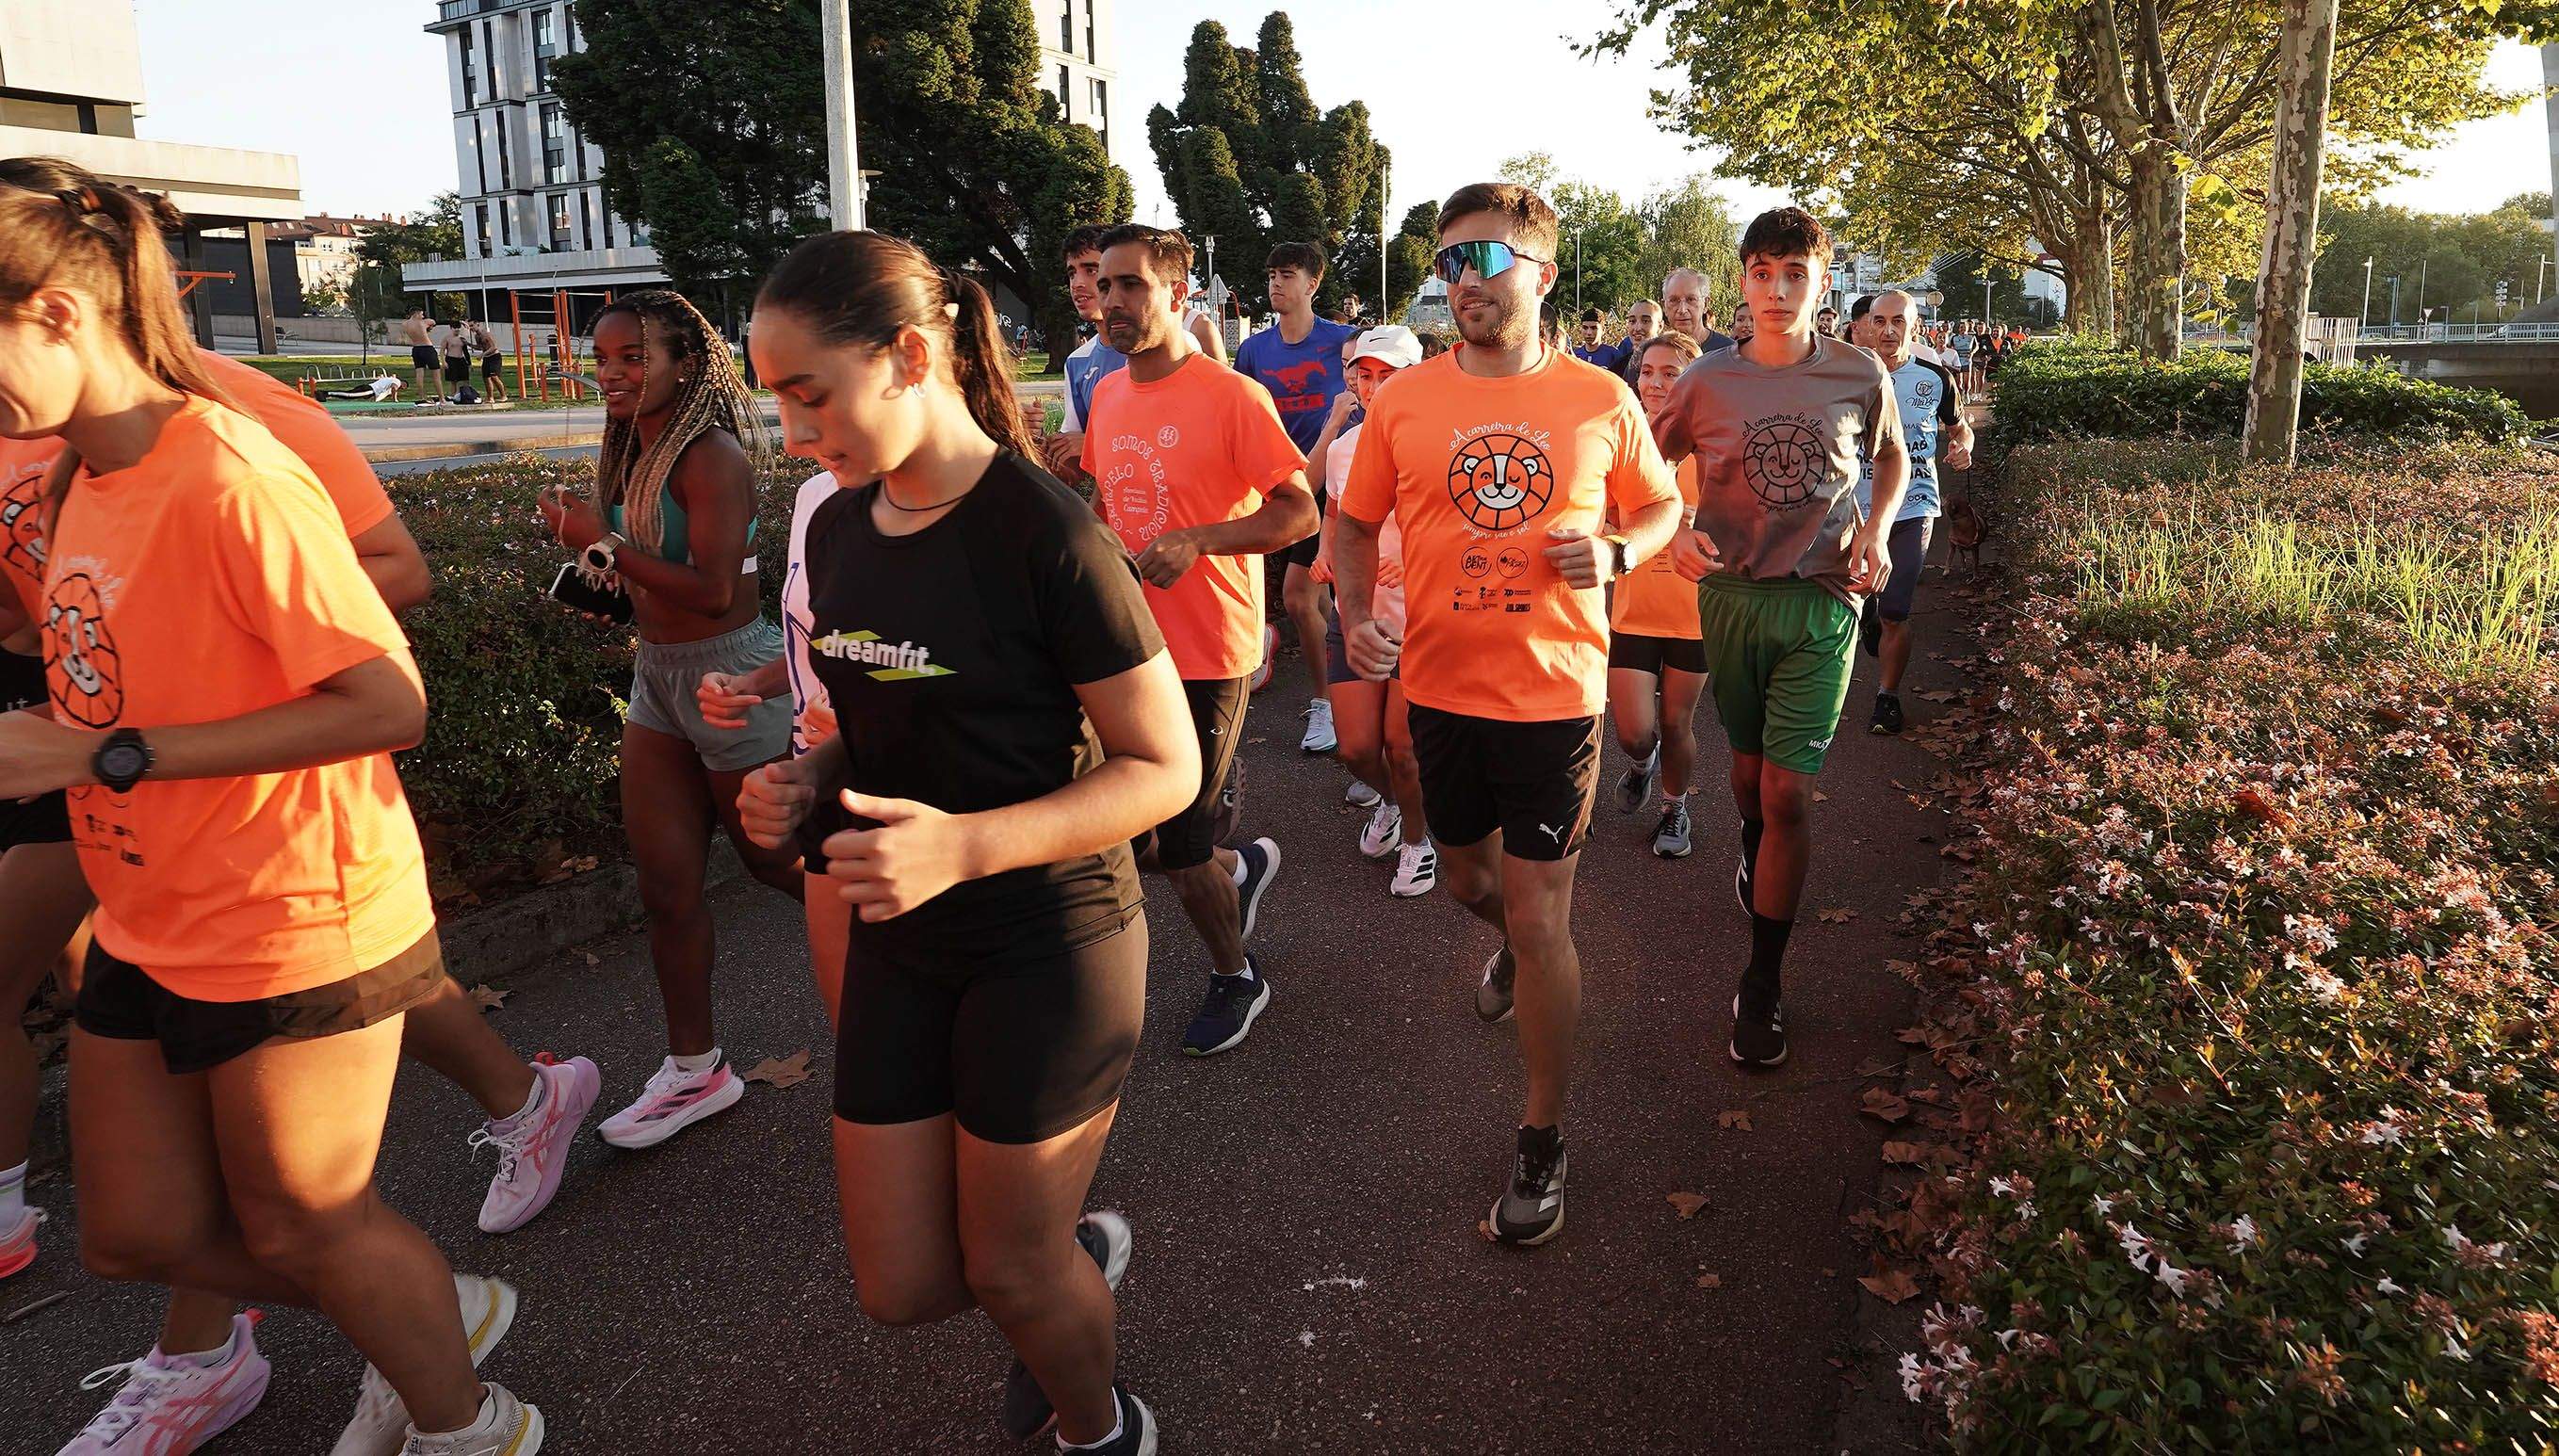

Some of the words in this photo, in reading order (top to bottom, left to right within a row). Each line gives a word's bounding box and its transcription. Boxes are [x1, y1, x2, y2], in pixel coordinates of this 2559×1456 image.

[1467, 421, 1514, 436] carreira
[1515, 421, 1531, 435] de
[1530, 430, 1552, 451] Leo
[1755, 413, 1793, 428] carreira
[1794, 412, 1806, 425] de
[1806, 418, 1824, 437] Leo
